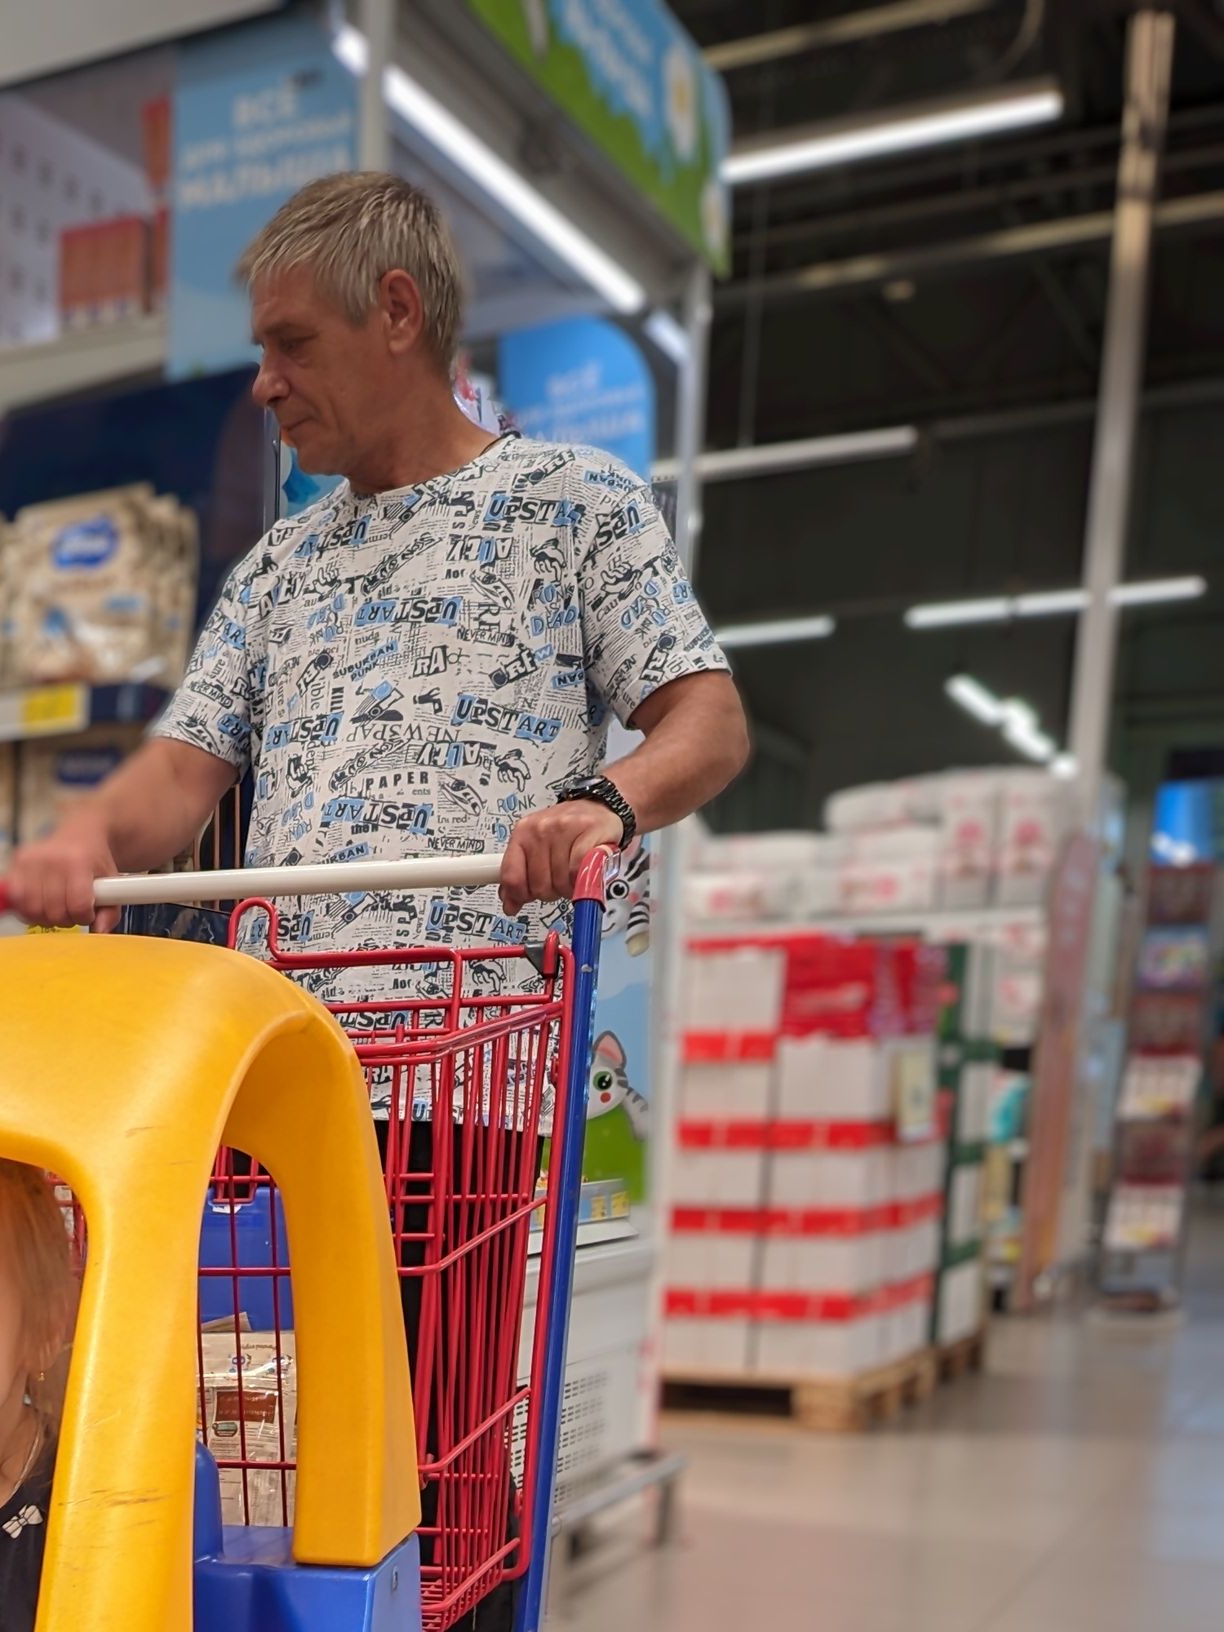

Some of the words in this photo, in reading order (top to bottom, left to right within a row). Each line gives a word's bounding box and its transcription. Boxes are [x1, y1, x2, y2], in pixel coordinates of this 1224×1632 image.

[356, 599, 459, 625] UPSTART
[333, 642, 395, 678] SUBURBAN
[457, 697, 560, 738] UPSTART
[366, 771, 429, 790] PAPER
[428, 838, 456, 851] NEVER
[431, 907, 523, 939] UPSTART
